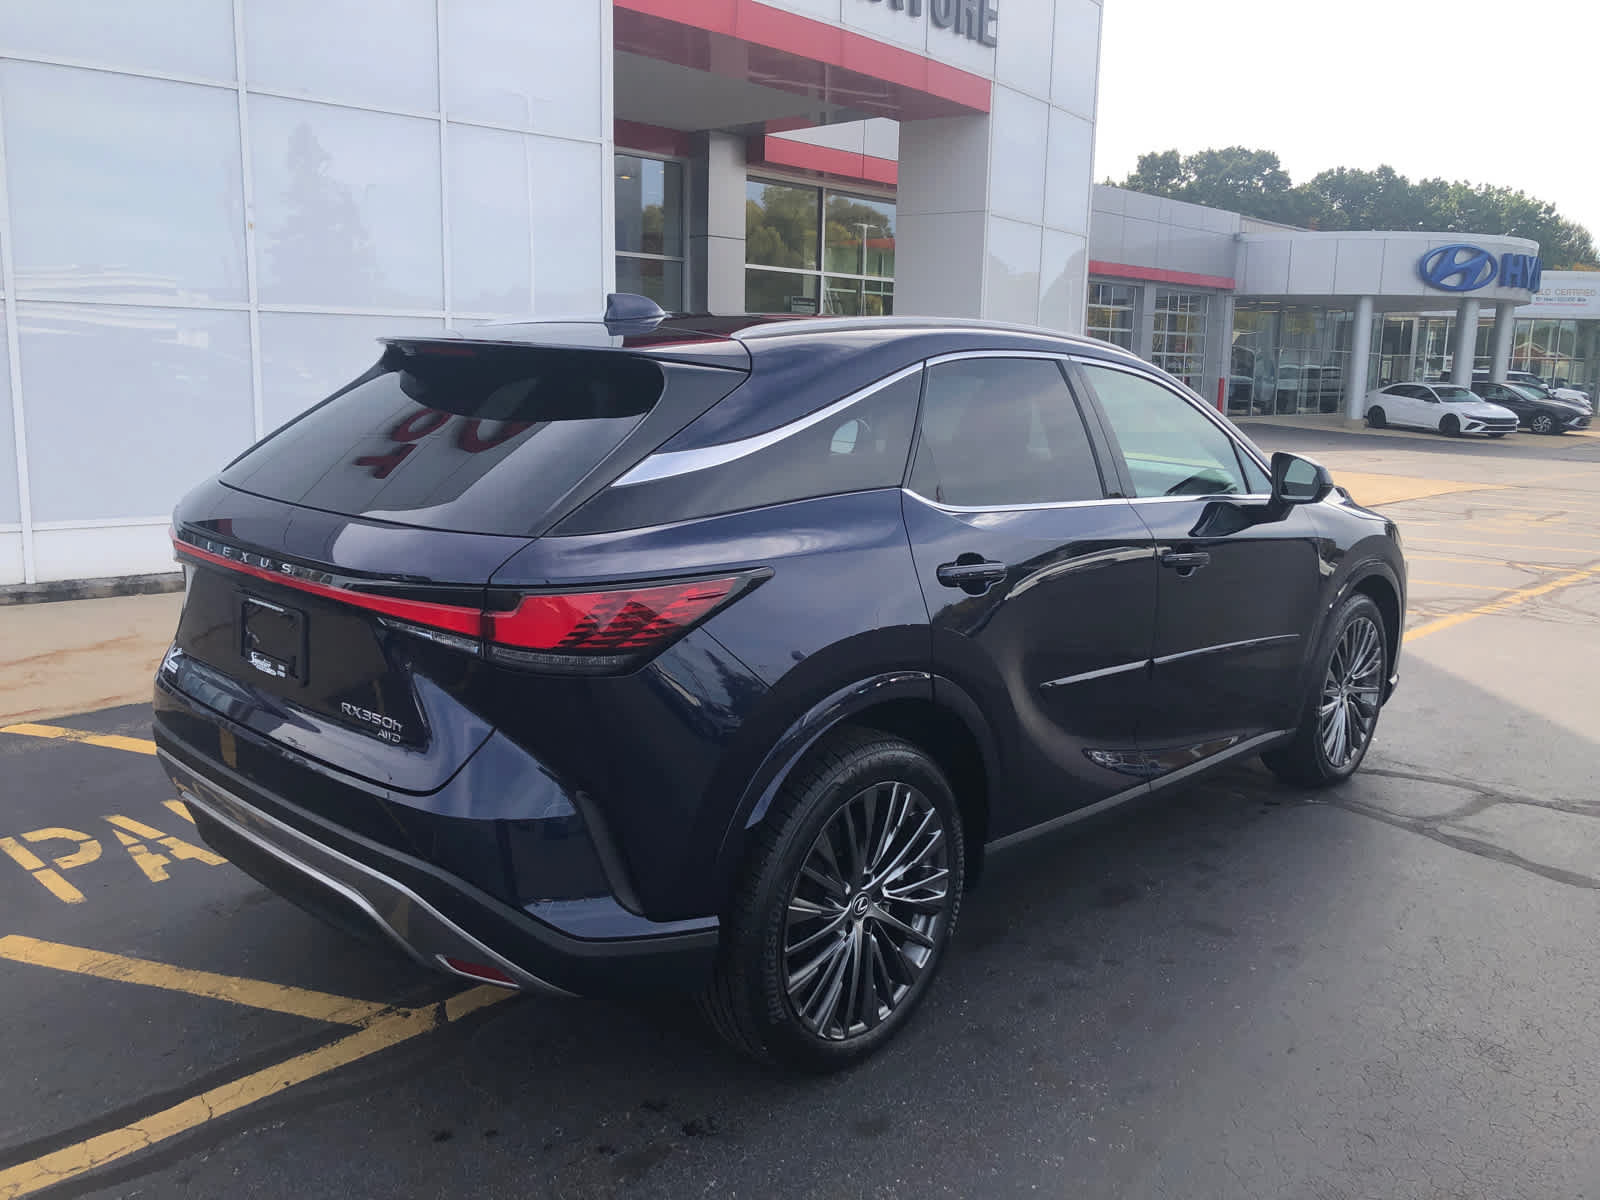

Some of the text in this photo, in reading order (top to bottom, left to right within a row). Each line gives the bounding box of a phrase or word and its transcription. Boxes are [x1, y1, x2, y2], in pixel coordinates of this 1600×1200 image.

[1500, 253, 1541, 292] HY
[206, 540, 293, 574] LEXUS
[341, 701, 403, 732] RX350h
[377, 728, 401, 743] AWD
[0, 800, 229, 904] PA
